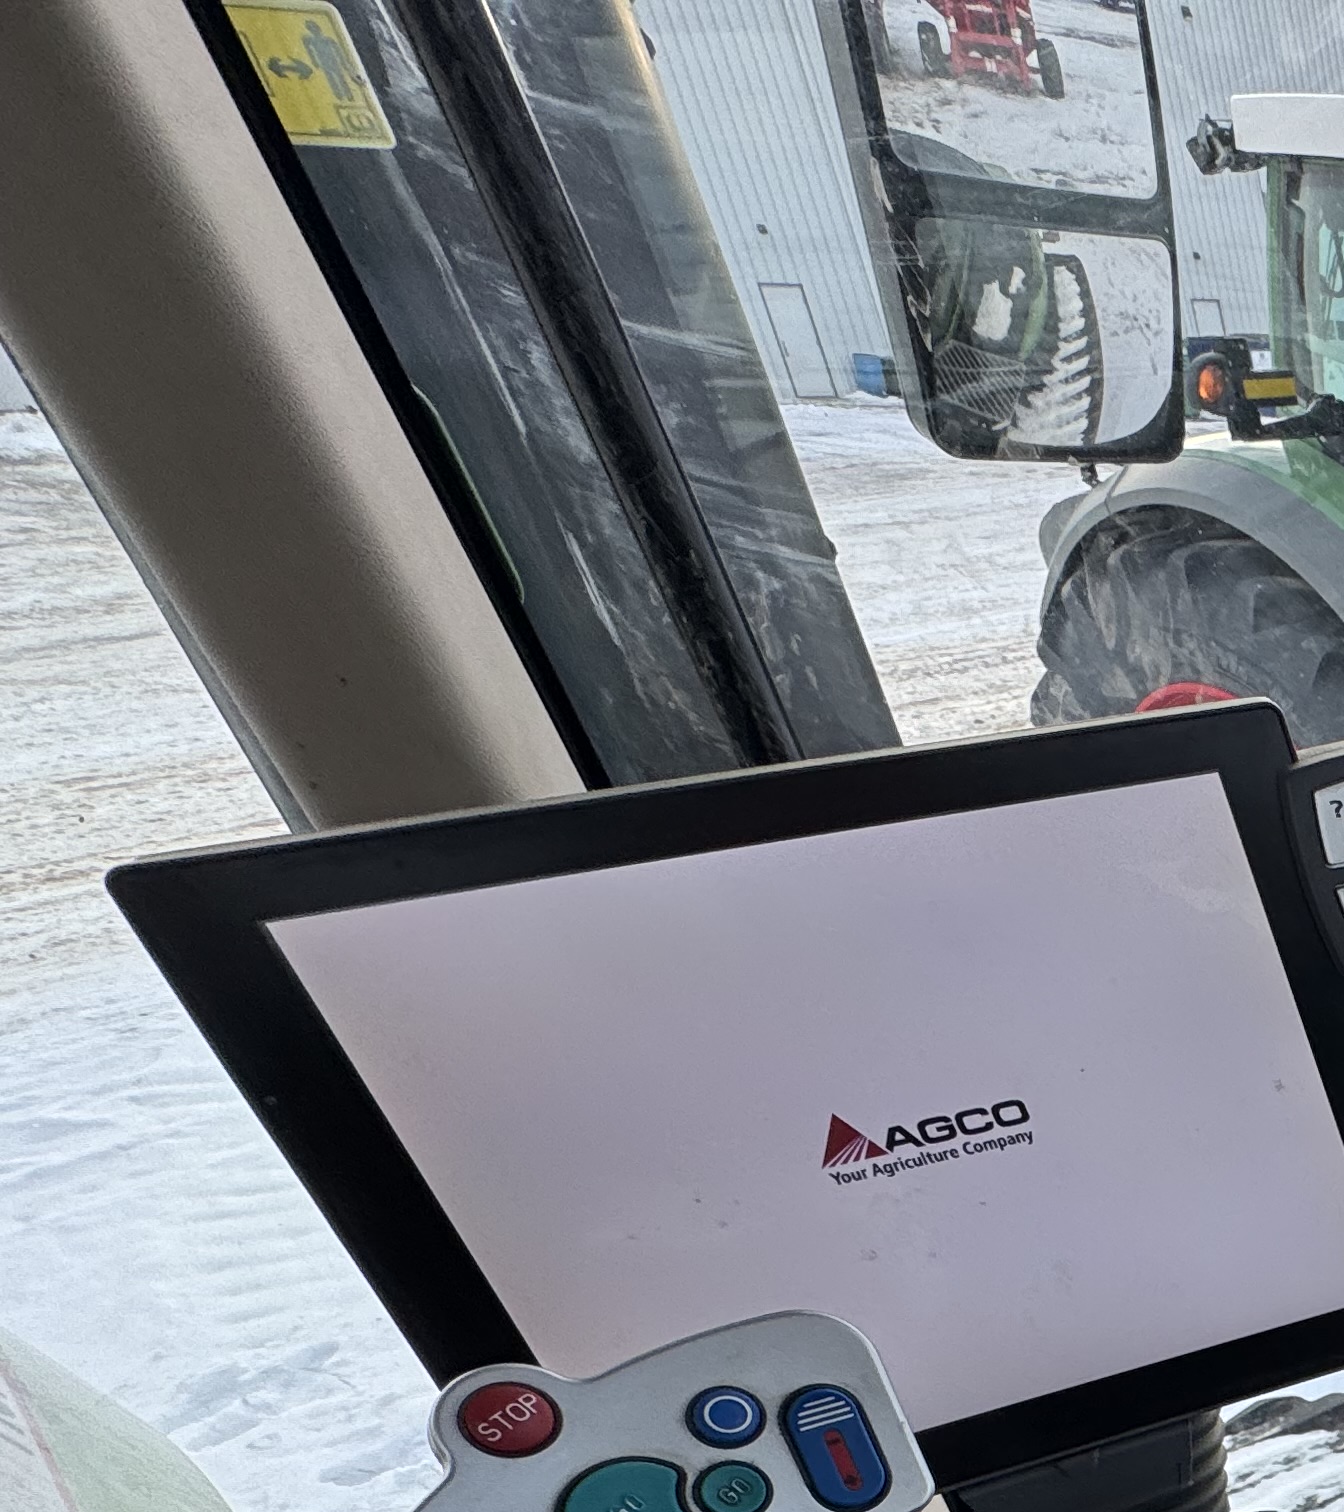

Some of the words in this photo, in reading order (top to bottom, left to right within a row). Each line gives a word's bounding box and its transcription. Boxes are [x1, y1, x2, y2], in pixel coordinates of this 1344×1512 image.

[885, 1099, 1030, 1153] AGCO
[829, 1167, 868, 1185] Your
[872, 1146, 960, 1178] Agriculture
[962, 1131, 1034, 1155] Company
[478, 1393, 539, 1442] STOP
[718, 1478, 752, 1504] GO
